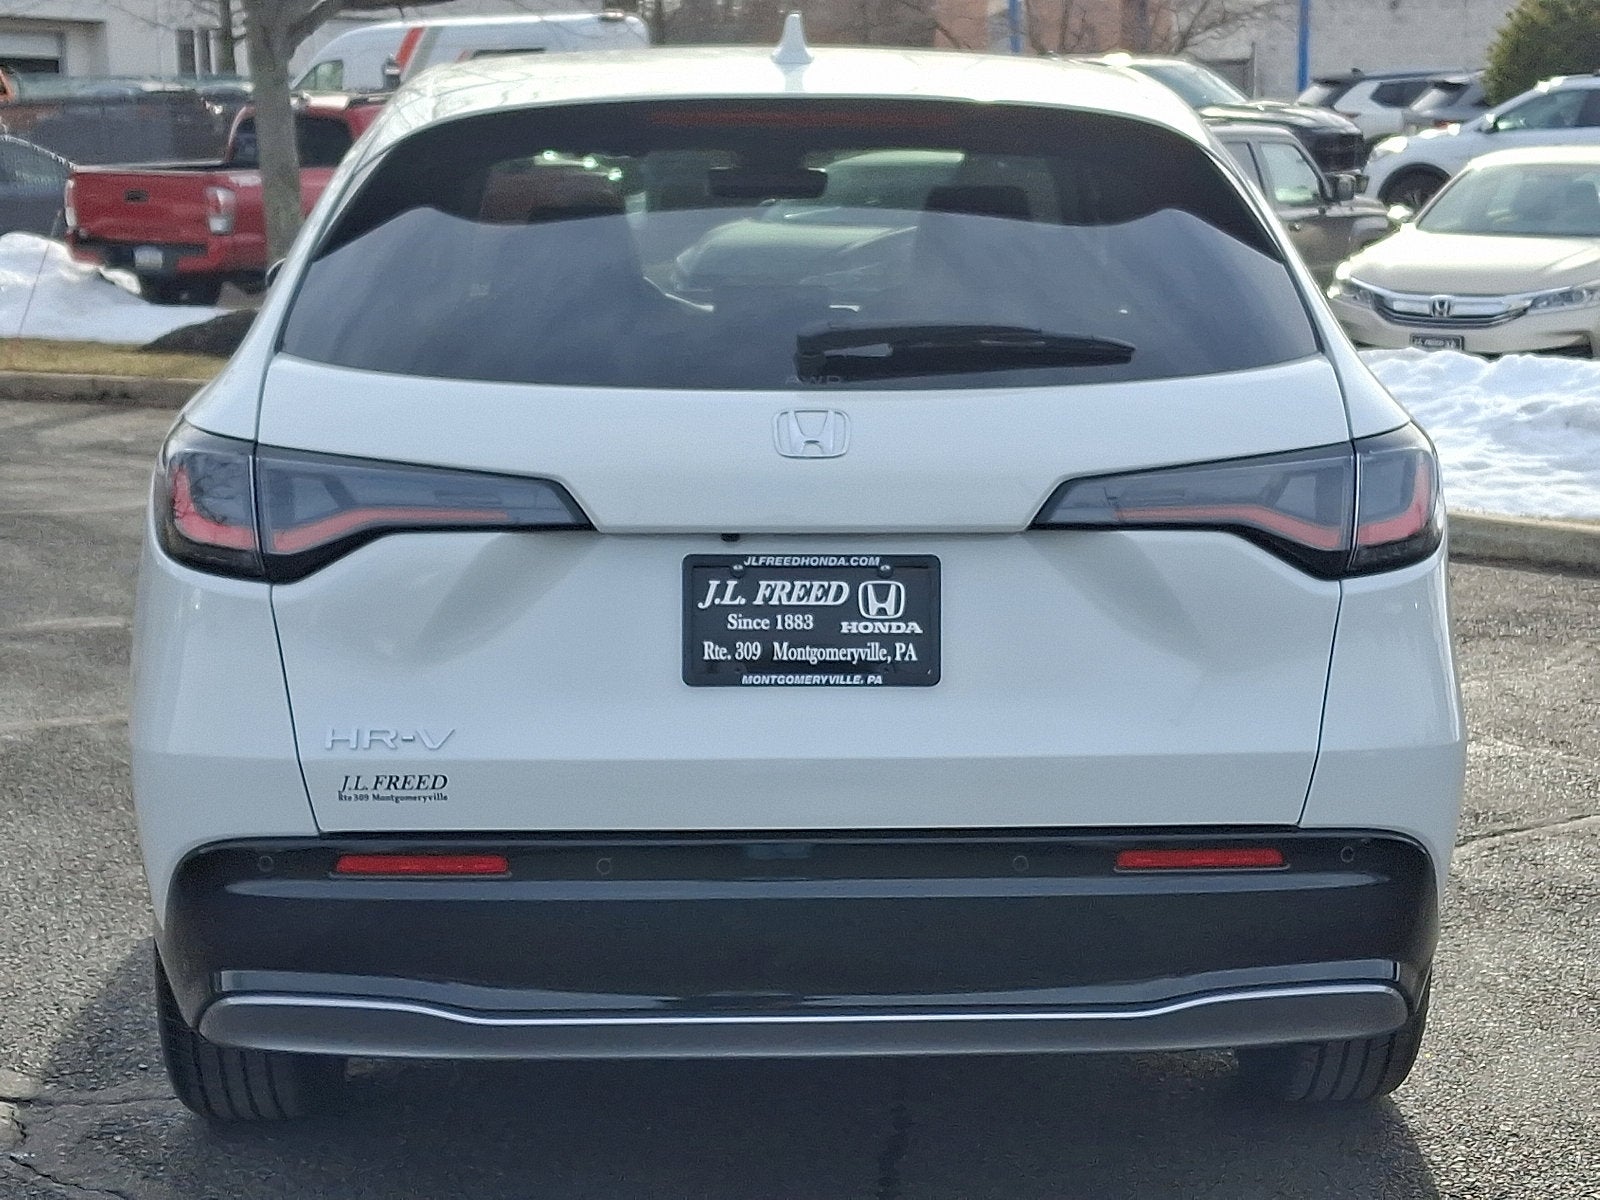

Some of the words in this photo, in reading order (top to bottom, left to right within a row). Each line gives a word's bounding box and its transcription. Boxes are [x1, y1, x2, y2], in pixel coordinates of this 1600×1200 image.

[744, 556, 880, 566] JLFREEDHONDA.COM
[698, 581, 746, 609] J.L.
[753, 581, 850, 605] FREED
[727, 613, 770, 630] Since
[776, 614, 814, 630] 1883
[840, 622, 923, 634] HONDA
[703, 641, 731, 661] Rte.
[736, 642, 761, 661] 309
[773, 642, 891, 664] Montgomeryville,
[895, 643, 918, 661] PA
[867, 675, 883, 685] PA
[325, 729, 455, 749] HR-V
[339, 775, 368, 792] J.L.
[372, 774, 448, 790] FREED
[372, 793, 448, 803] Montgomeryville
